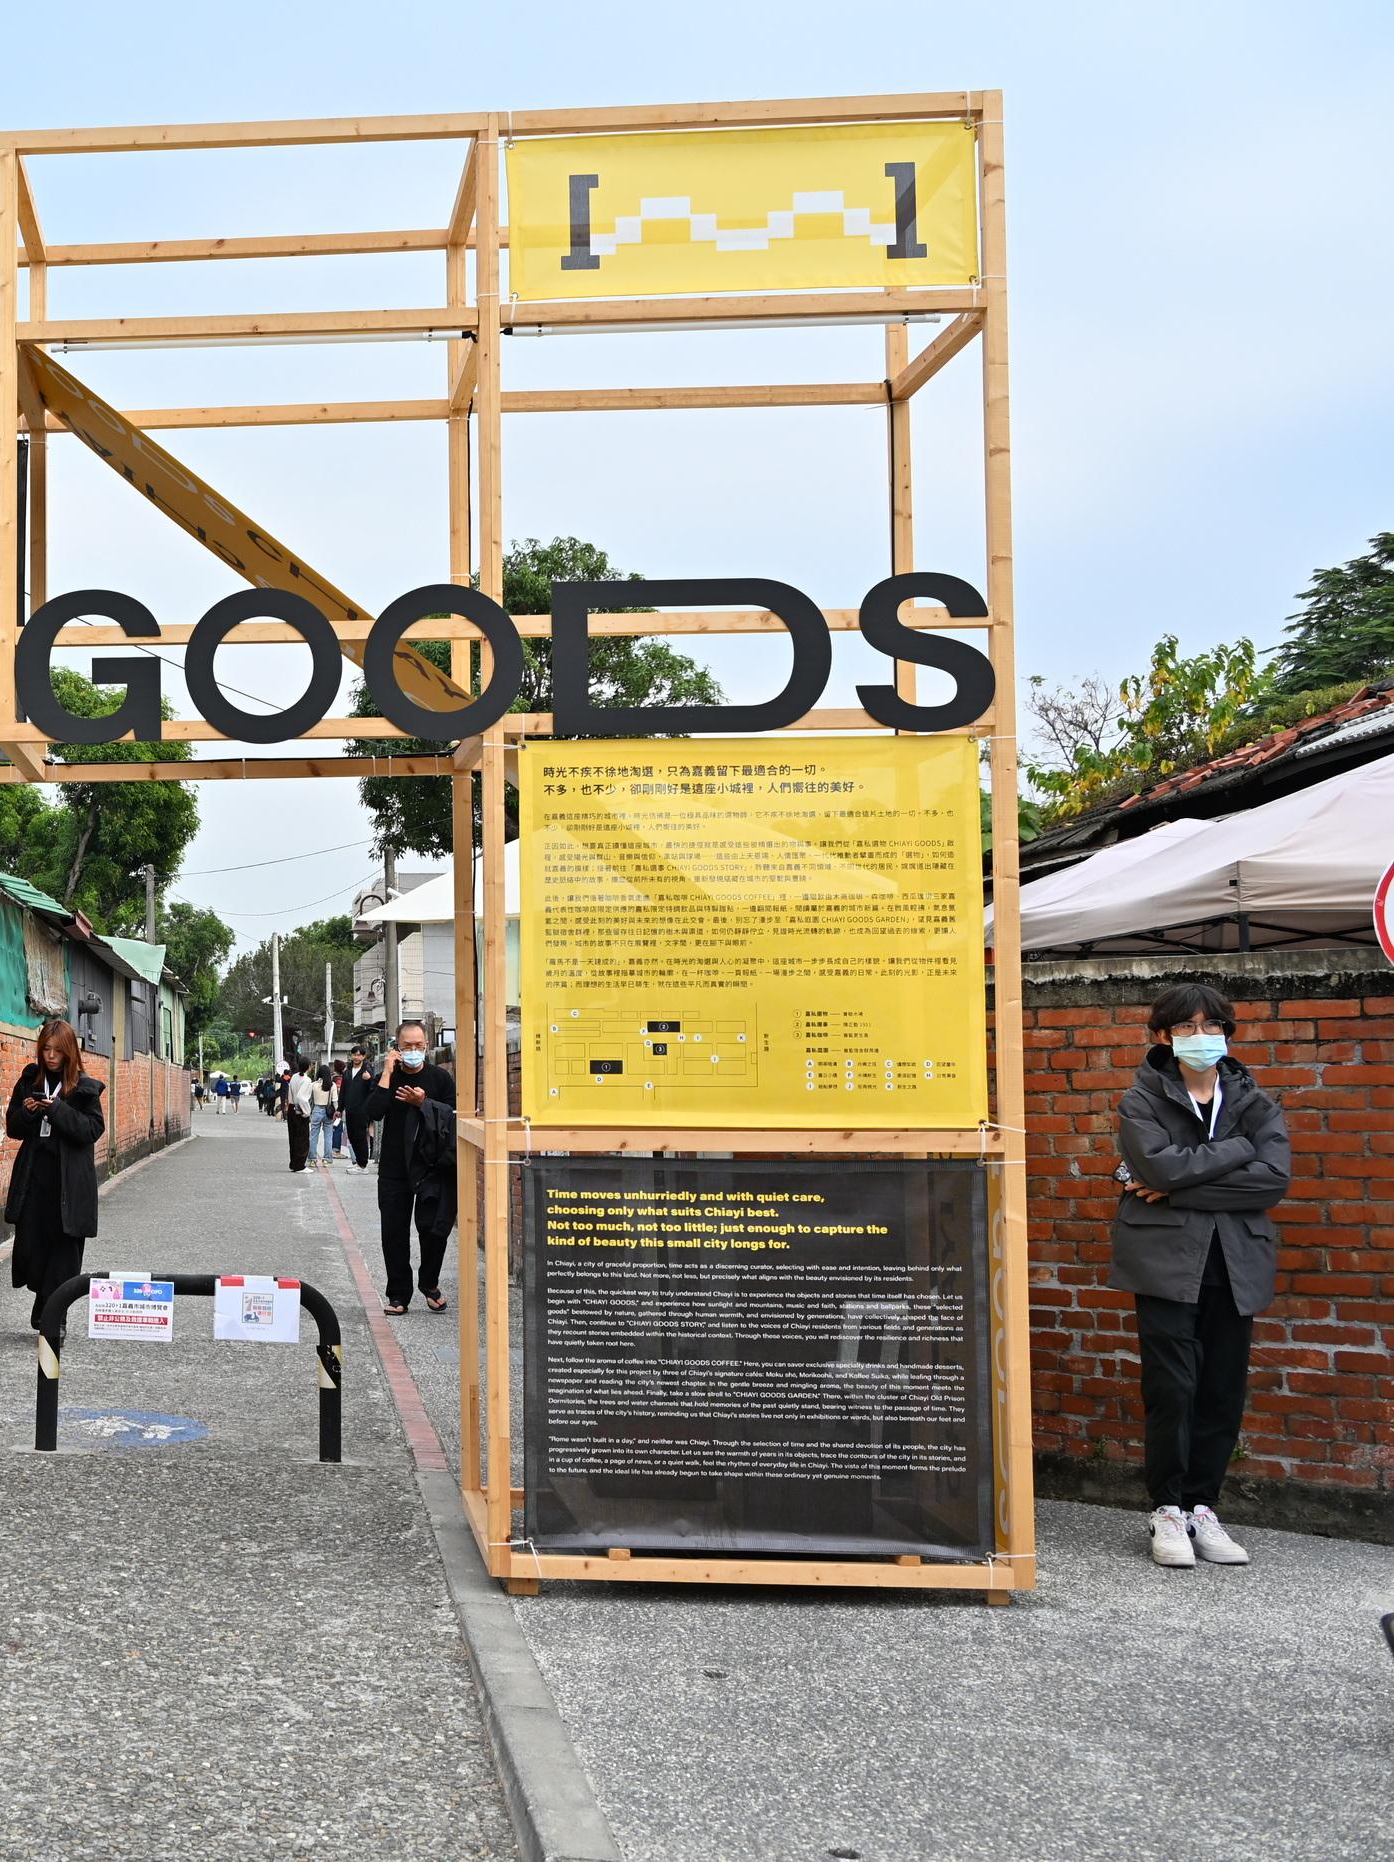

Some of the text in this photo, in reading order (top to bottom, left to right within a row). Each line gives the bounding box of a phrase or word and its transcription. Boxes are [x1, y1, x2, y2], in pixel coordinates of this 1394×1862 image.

[14, 572, 996, 744] GOODS
[546, 1189, 825, 1204] Time moves unhurriedly and with quiet care,
[547, 1205, 779, 1218] choosing only what suits Chiayi best.
[547, 1220, 888, 1235] Not too much, not too little; just enough to capture the
[547, 1236, 790, 1251] kind of beauty this small city longs for.
[583, 1260, 596, 1268] city
[605, 1261, 632, 1269] graceful
[775, 1263, 805, 1271] selecting
[882, 1264, 907, 1272] leaving
[547, 1270, 576, 1278] perfectly
[575, 1270, 602, 1279] belongs
[711, 1273, 741, 1281] precisely
[758, 1273, 779, 1281] aligns
[805, 1274, 829, 1282] beauty
